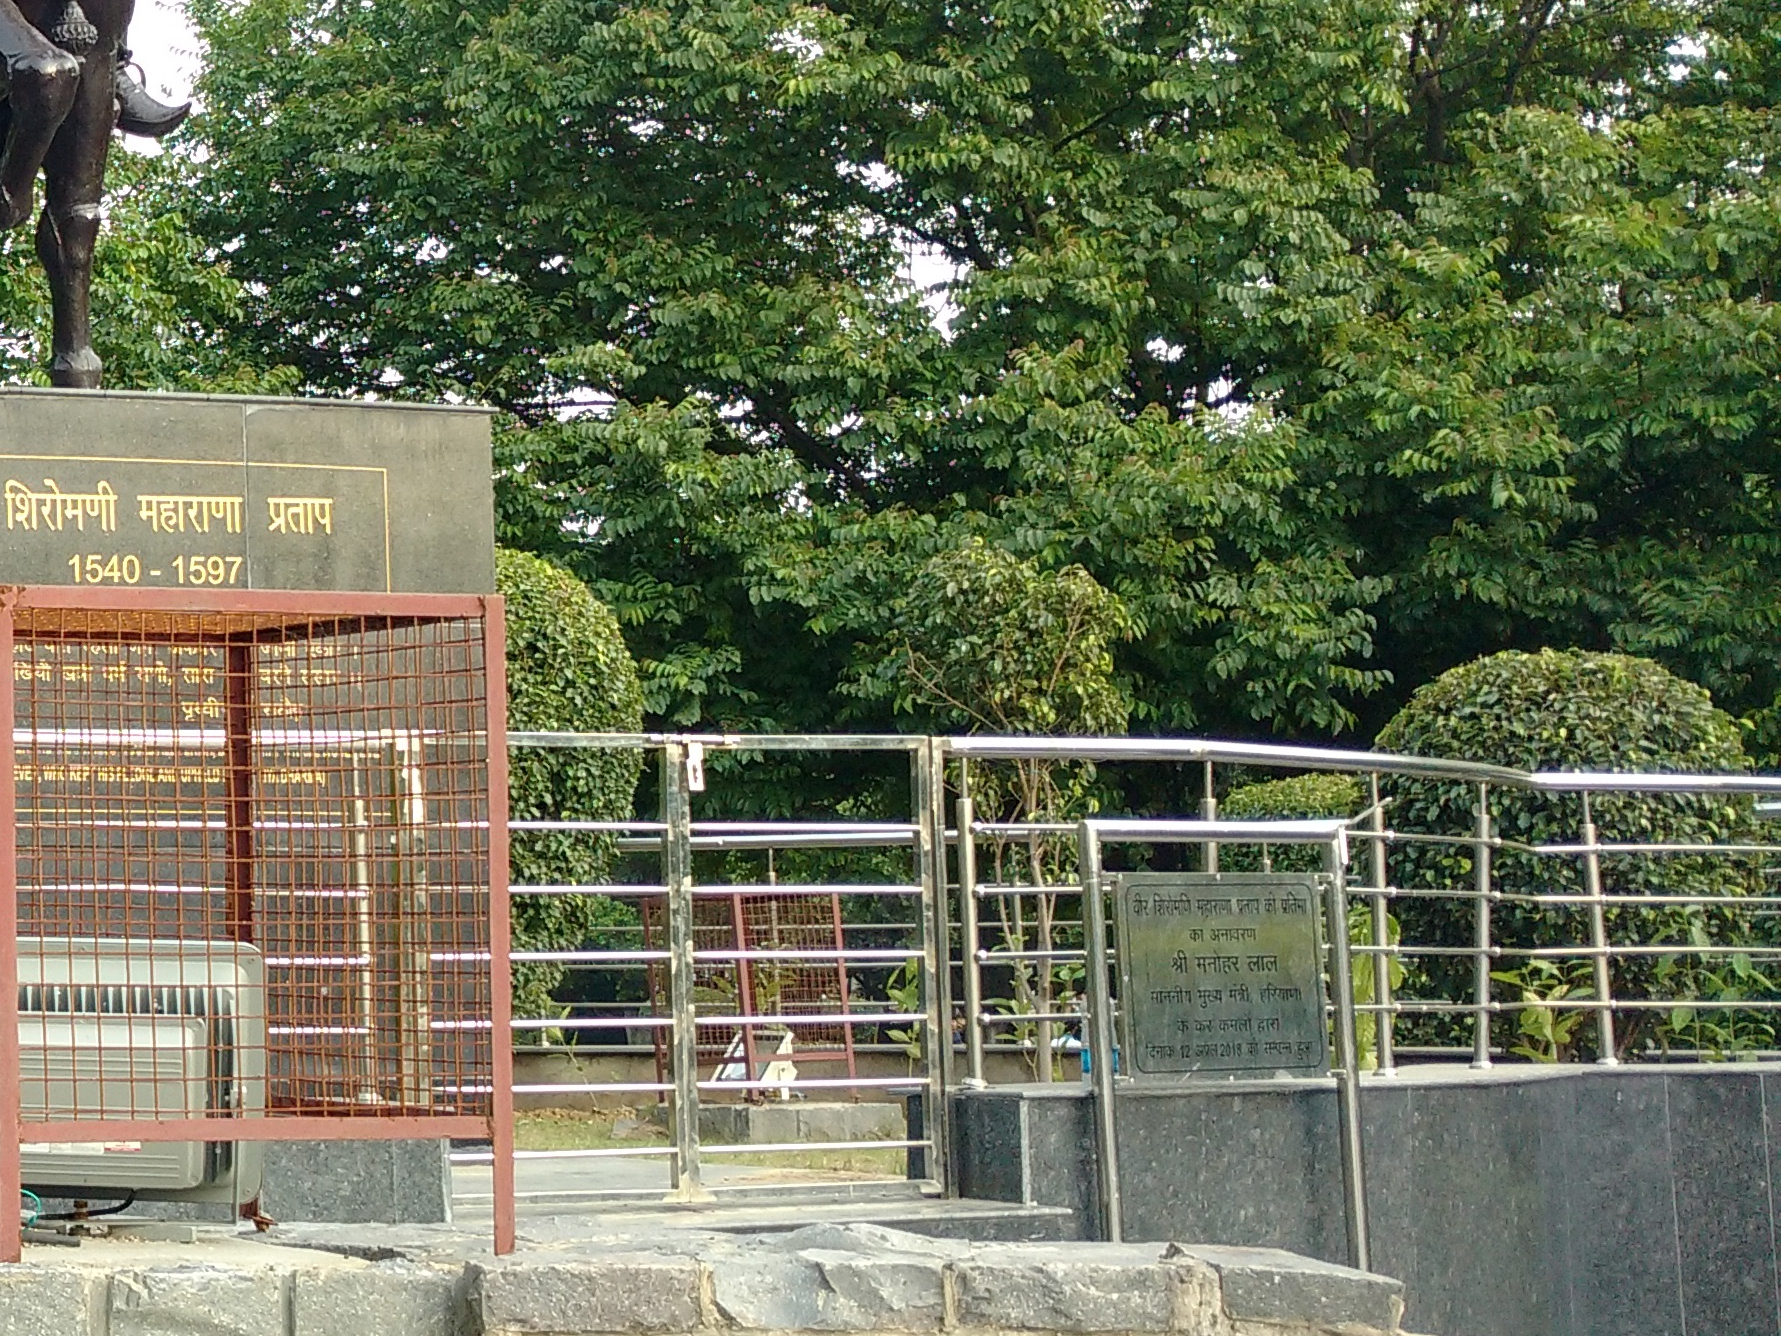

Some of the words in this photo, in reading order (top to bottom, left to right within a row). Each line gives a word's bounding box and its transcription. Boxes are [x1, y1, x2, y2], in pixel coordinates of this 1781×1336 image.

[3, 478, 118, 532] शिरोमणी
[136, 495, 243, 534] महाराणा
[266, 497, 334, 535] प्रताप
[68, 554, 139, 584] 1540
[171, 555, 243, 585] 1597
[1189, 928, 1204, 943] का
[1209, 928, 1257, 943] अनावरण
[1171, 950, 1188, 974] श्री
[1194, 951, 1240, 974] मनोहर
[1246, 954, 1278, 973] लाल
[1150, 985, 1192, 1005] माननीय
[1197, 988, 1223, 1009] मुख्य
[1259, 983, 1302, 1005] हरियाणा
[1194, 1018, 1212, 1033] कर
[1180, 1045, 1191, 1059] 12
